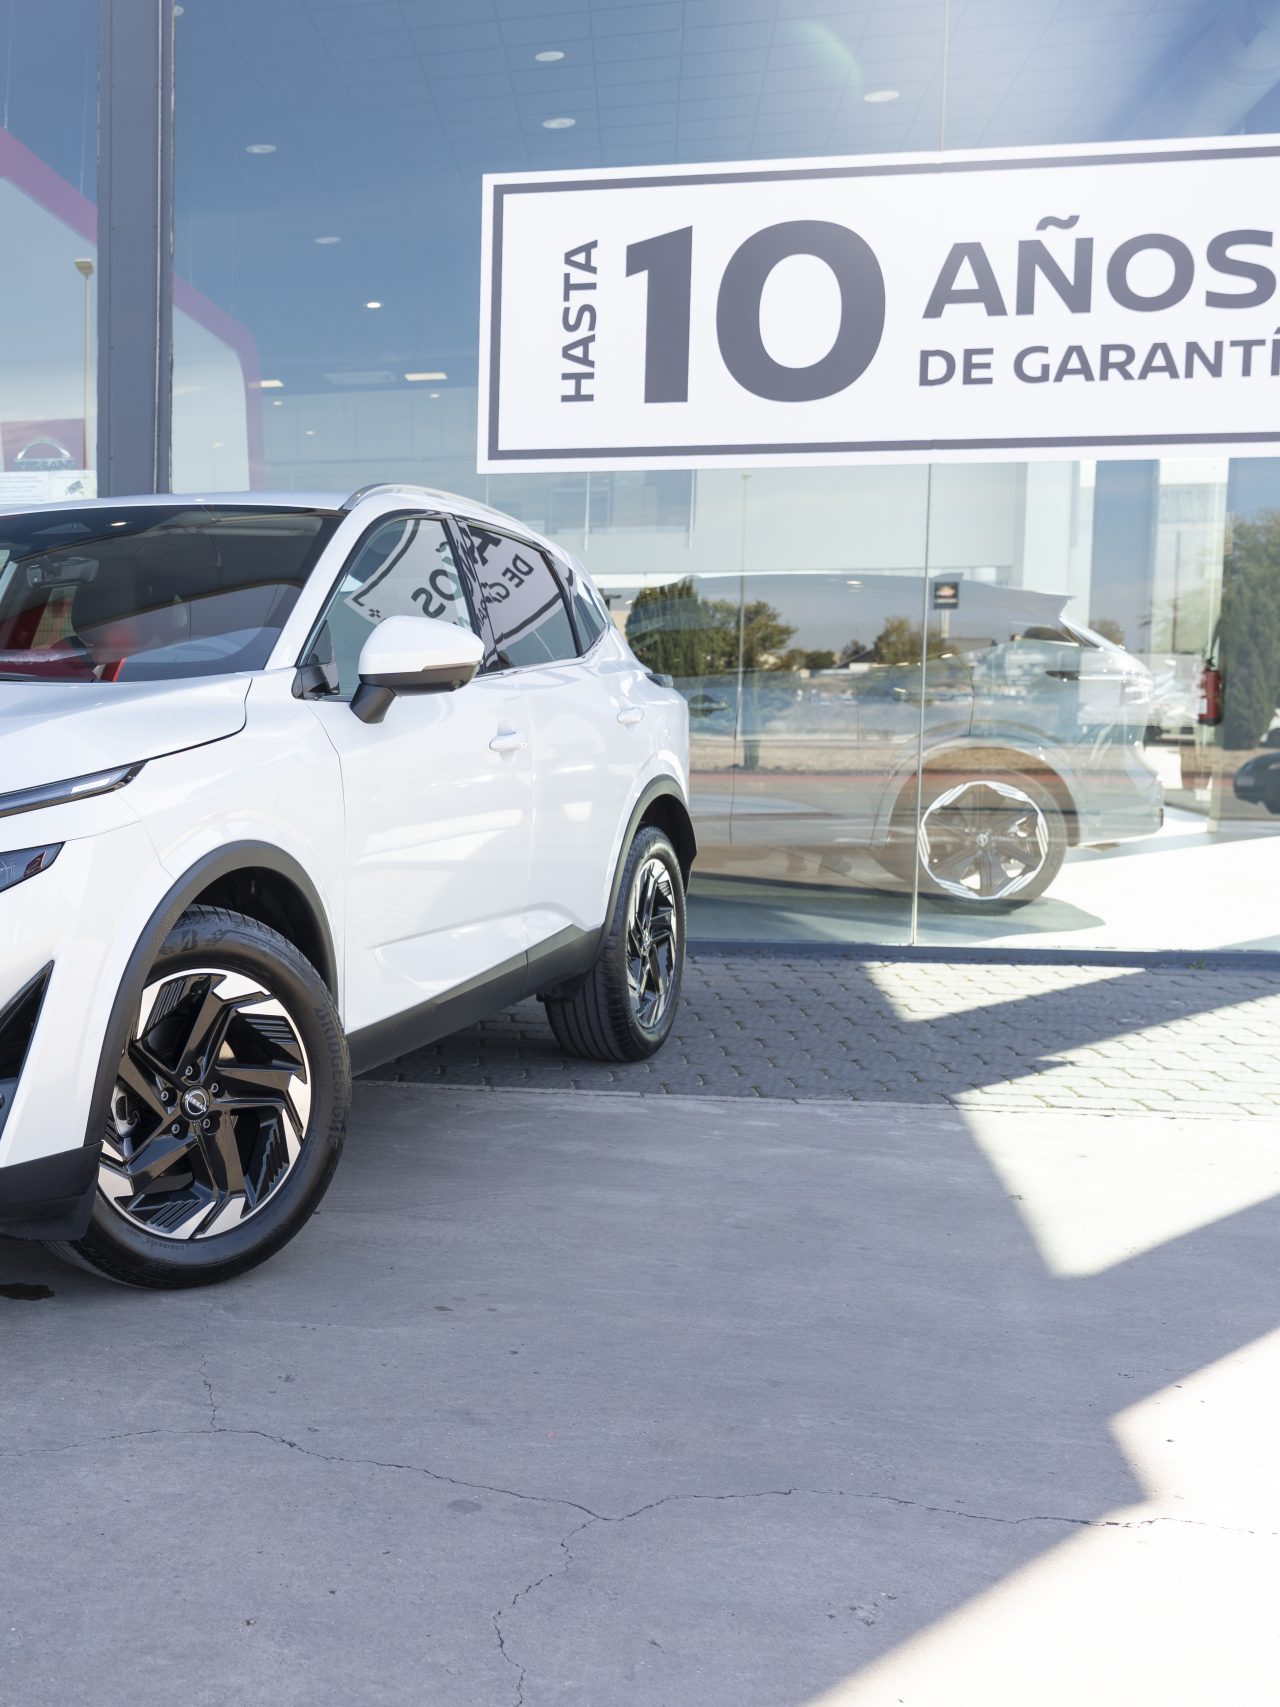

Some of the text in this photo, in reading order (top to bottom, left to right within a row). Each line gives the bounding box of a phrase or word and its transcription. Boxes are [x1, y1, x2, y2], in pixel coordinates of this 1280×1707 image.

[560, 239, 599, 403] HASTA
[625, 214, 1277, 403] 10 AÑOS
[919, 347, 995, 387] DE
